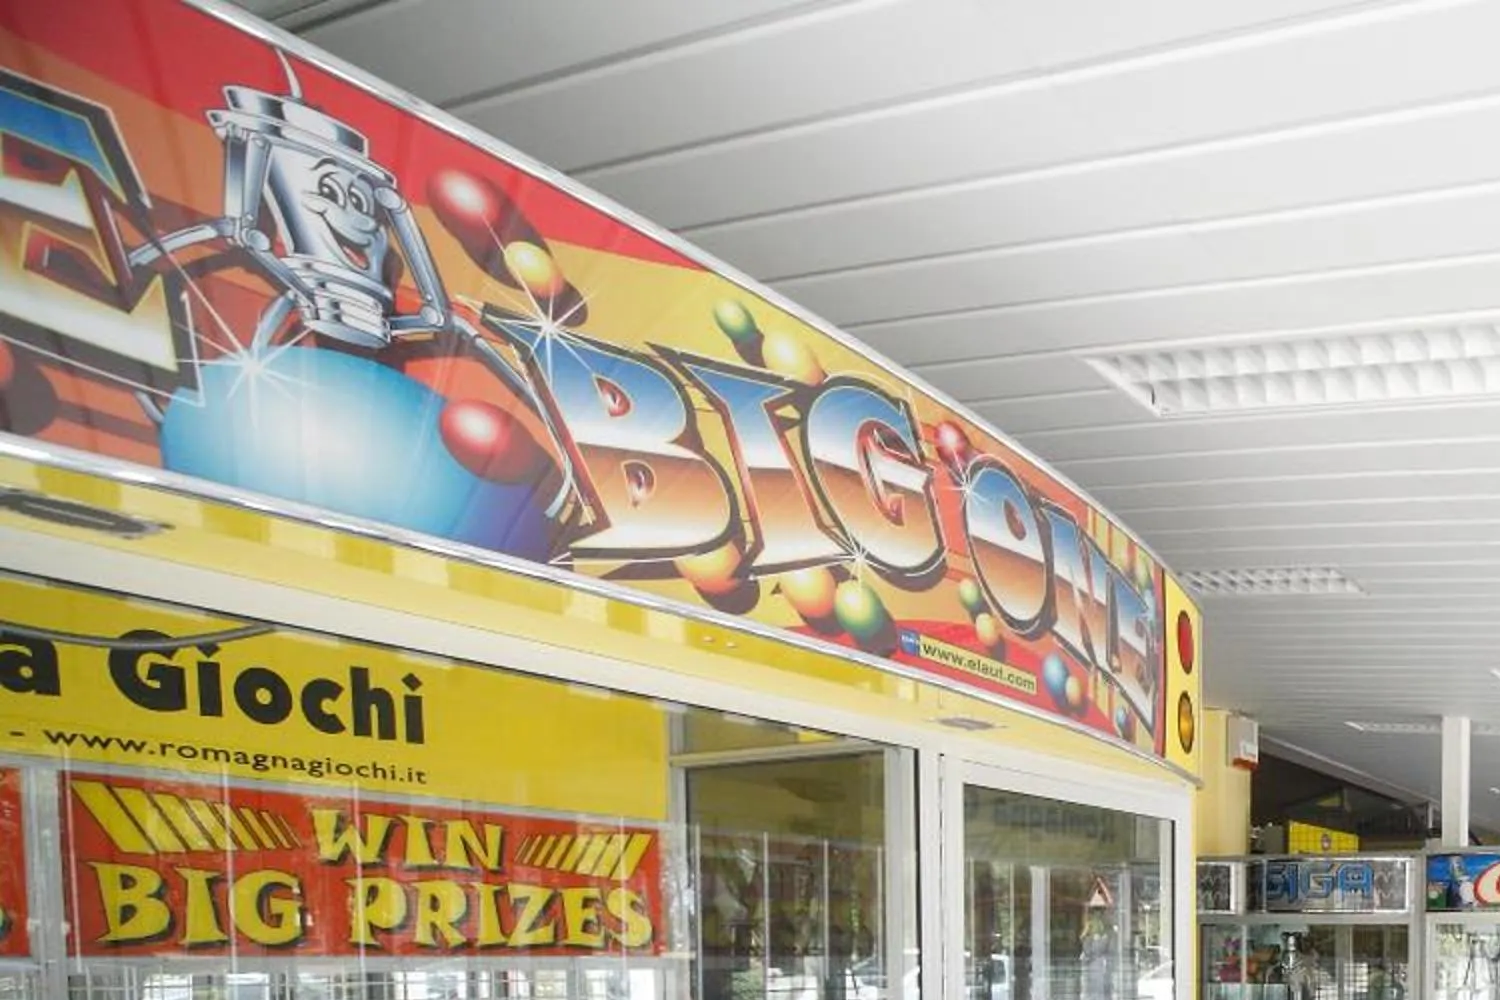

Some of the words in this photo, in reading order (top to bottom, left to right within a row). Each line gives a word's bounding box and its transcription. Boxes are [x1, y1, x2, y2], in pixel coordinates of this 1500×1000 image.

[470, 305, 946, 580] BIG
[963, 454, 1156, 732] ONE
[108, 625, 425, 745] Giochi
[43, 729, 427, 786] www.romagnagiochi.it
[307, 806, 506, 874] WIN
[87, 860, 303, 948] BIG
[345, 875, 654, 952] PRIZES
